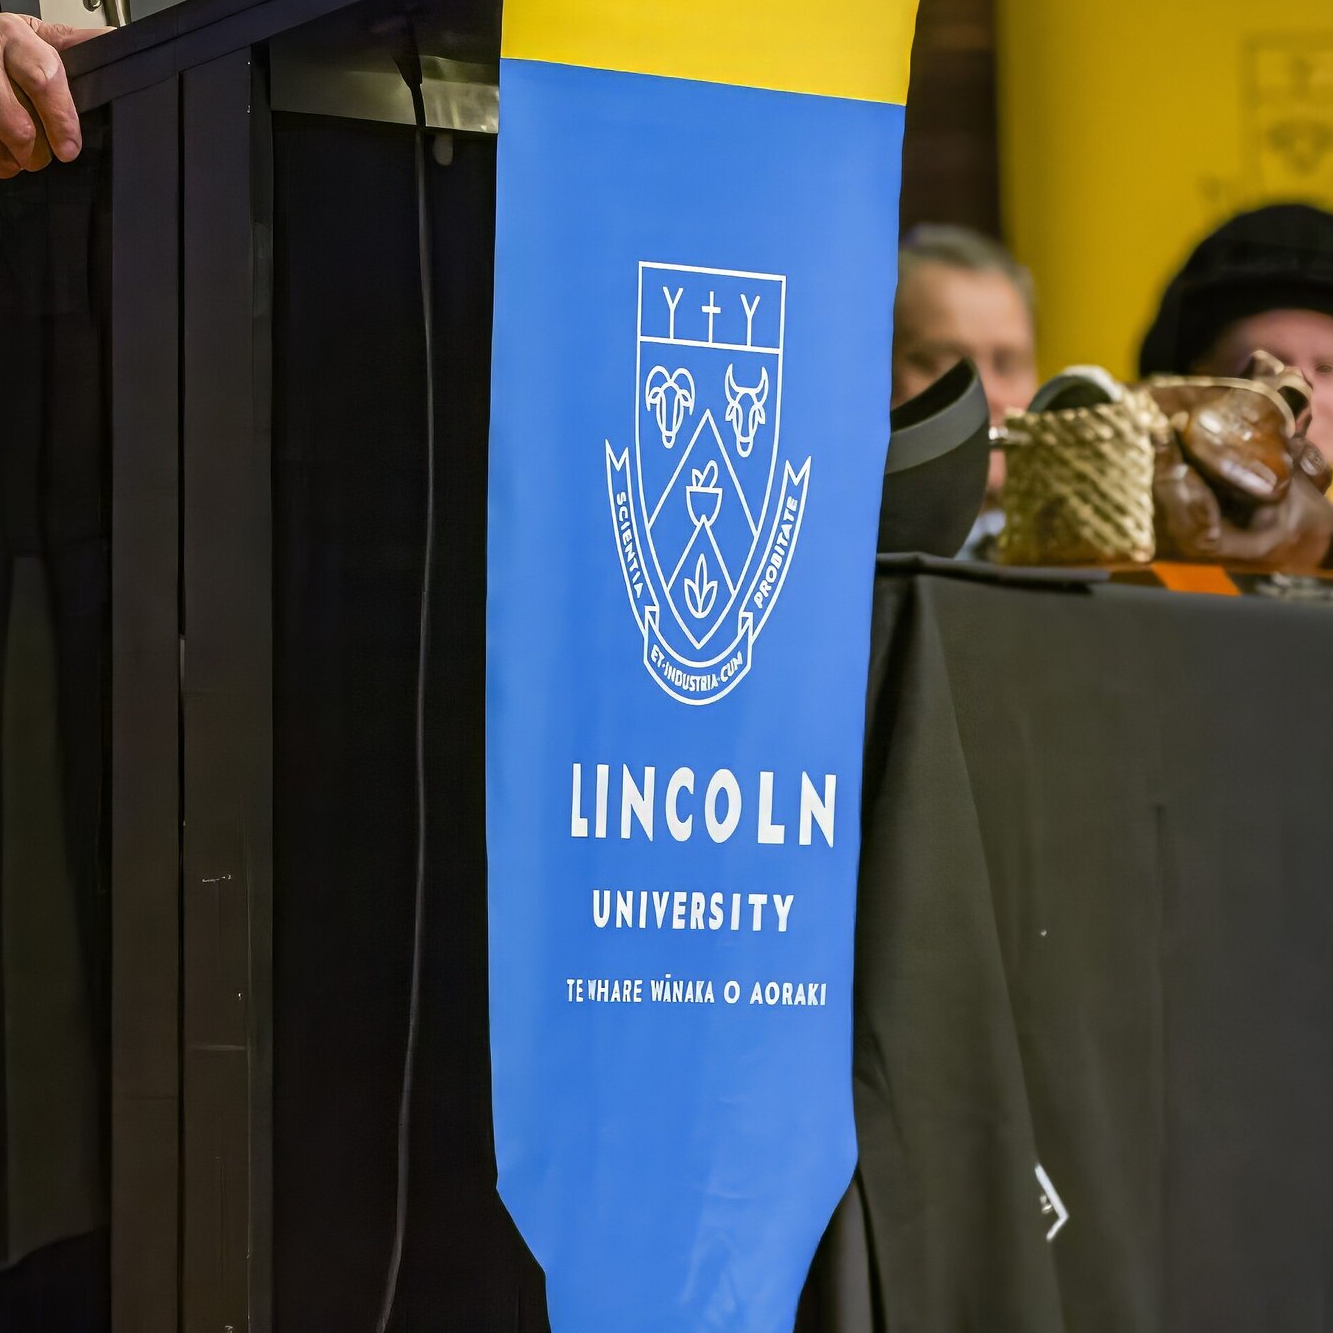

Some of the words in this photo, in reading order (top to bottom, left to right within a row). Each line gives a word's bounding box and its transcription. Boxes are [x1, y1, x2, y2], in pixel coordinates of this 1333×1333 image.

[616, 491, 644, 599] SCIENTIA
[753, 495, 799, 609] PROBITATE
[570, 762, 838, 848] LINCOLN
[591, 889, 795, 933] UNIVERSITY
[566, 978, 584, 1003] TE
[587, 978, 643, 1004] WHARE
[723, 980, 741, 1005] O
[749, 981, 828, 1006] AORAKI
